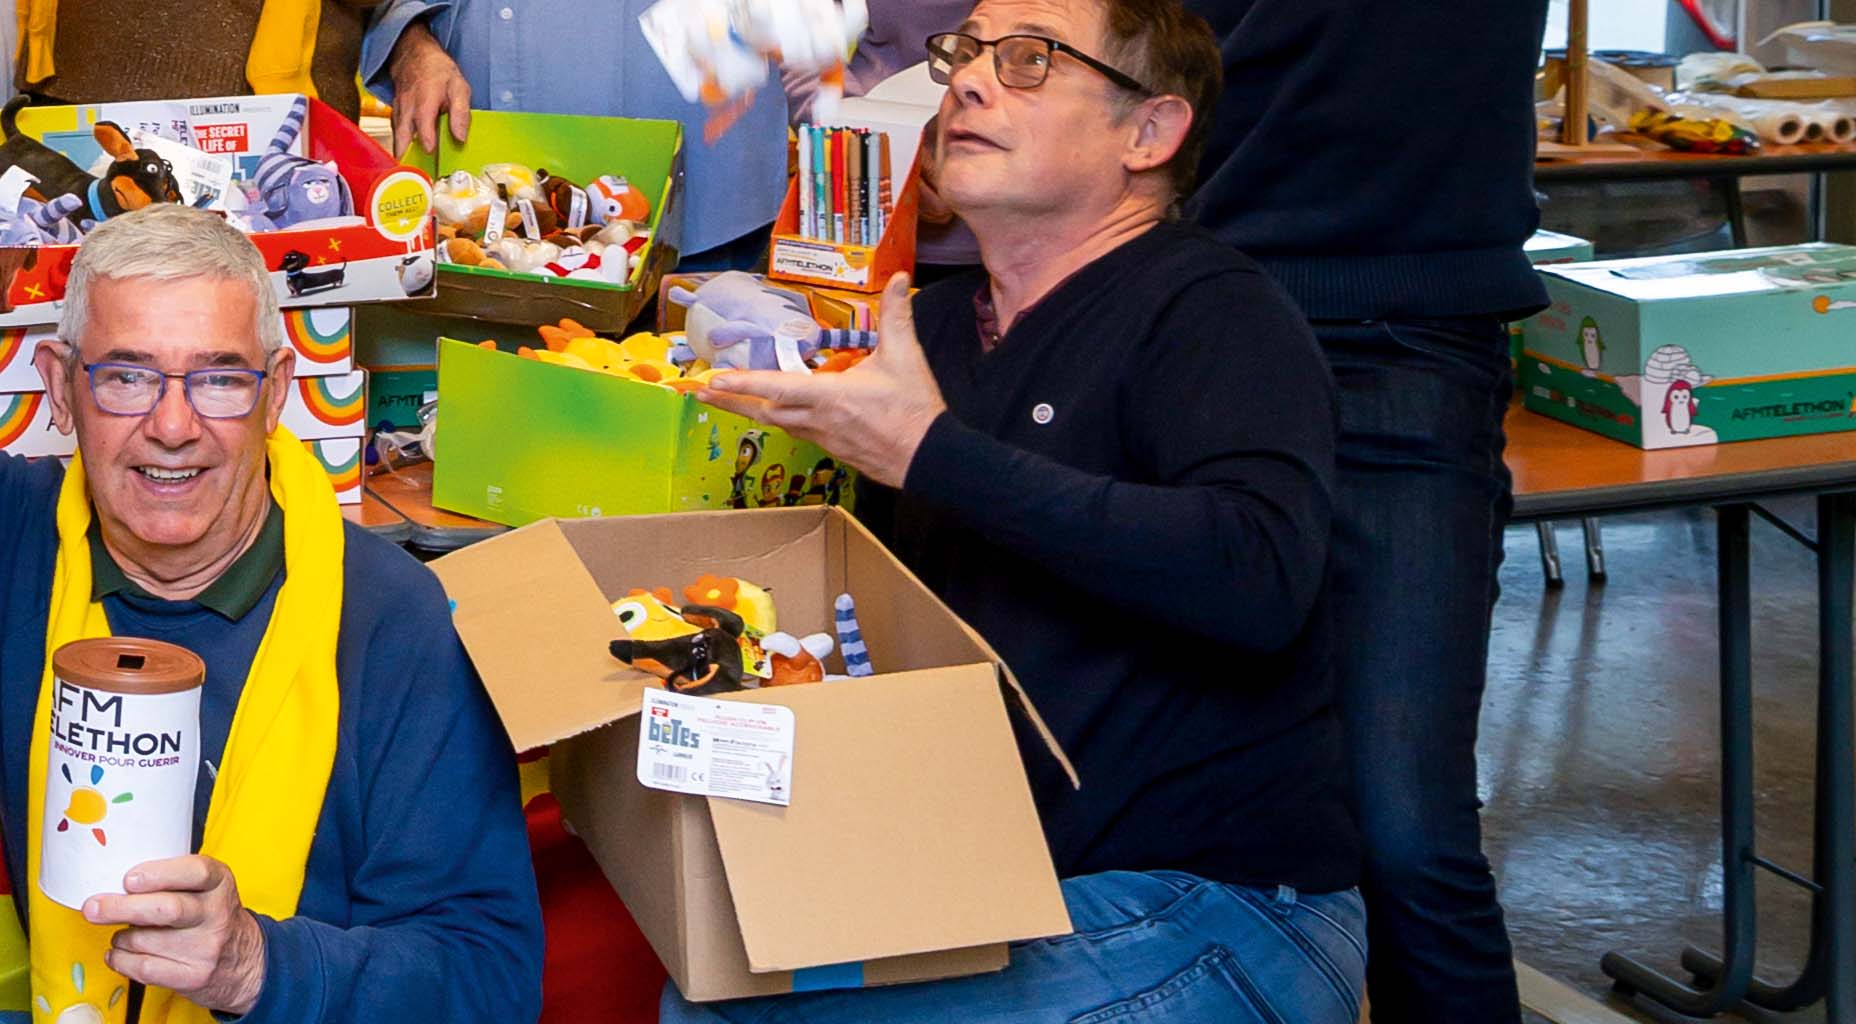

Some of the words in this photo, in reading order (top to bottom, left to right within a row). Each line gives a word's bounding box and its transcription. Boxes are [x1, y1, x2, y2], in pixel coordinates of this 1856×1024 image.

[189, 103, 240, 115] ILLUMINATION
[209, 125, 245, 138] SECRET
[377, 193, 424, 213] COLLECT
[54, 742, 95, 762] INNOVER
[99, 756, 135, 767] POUR
